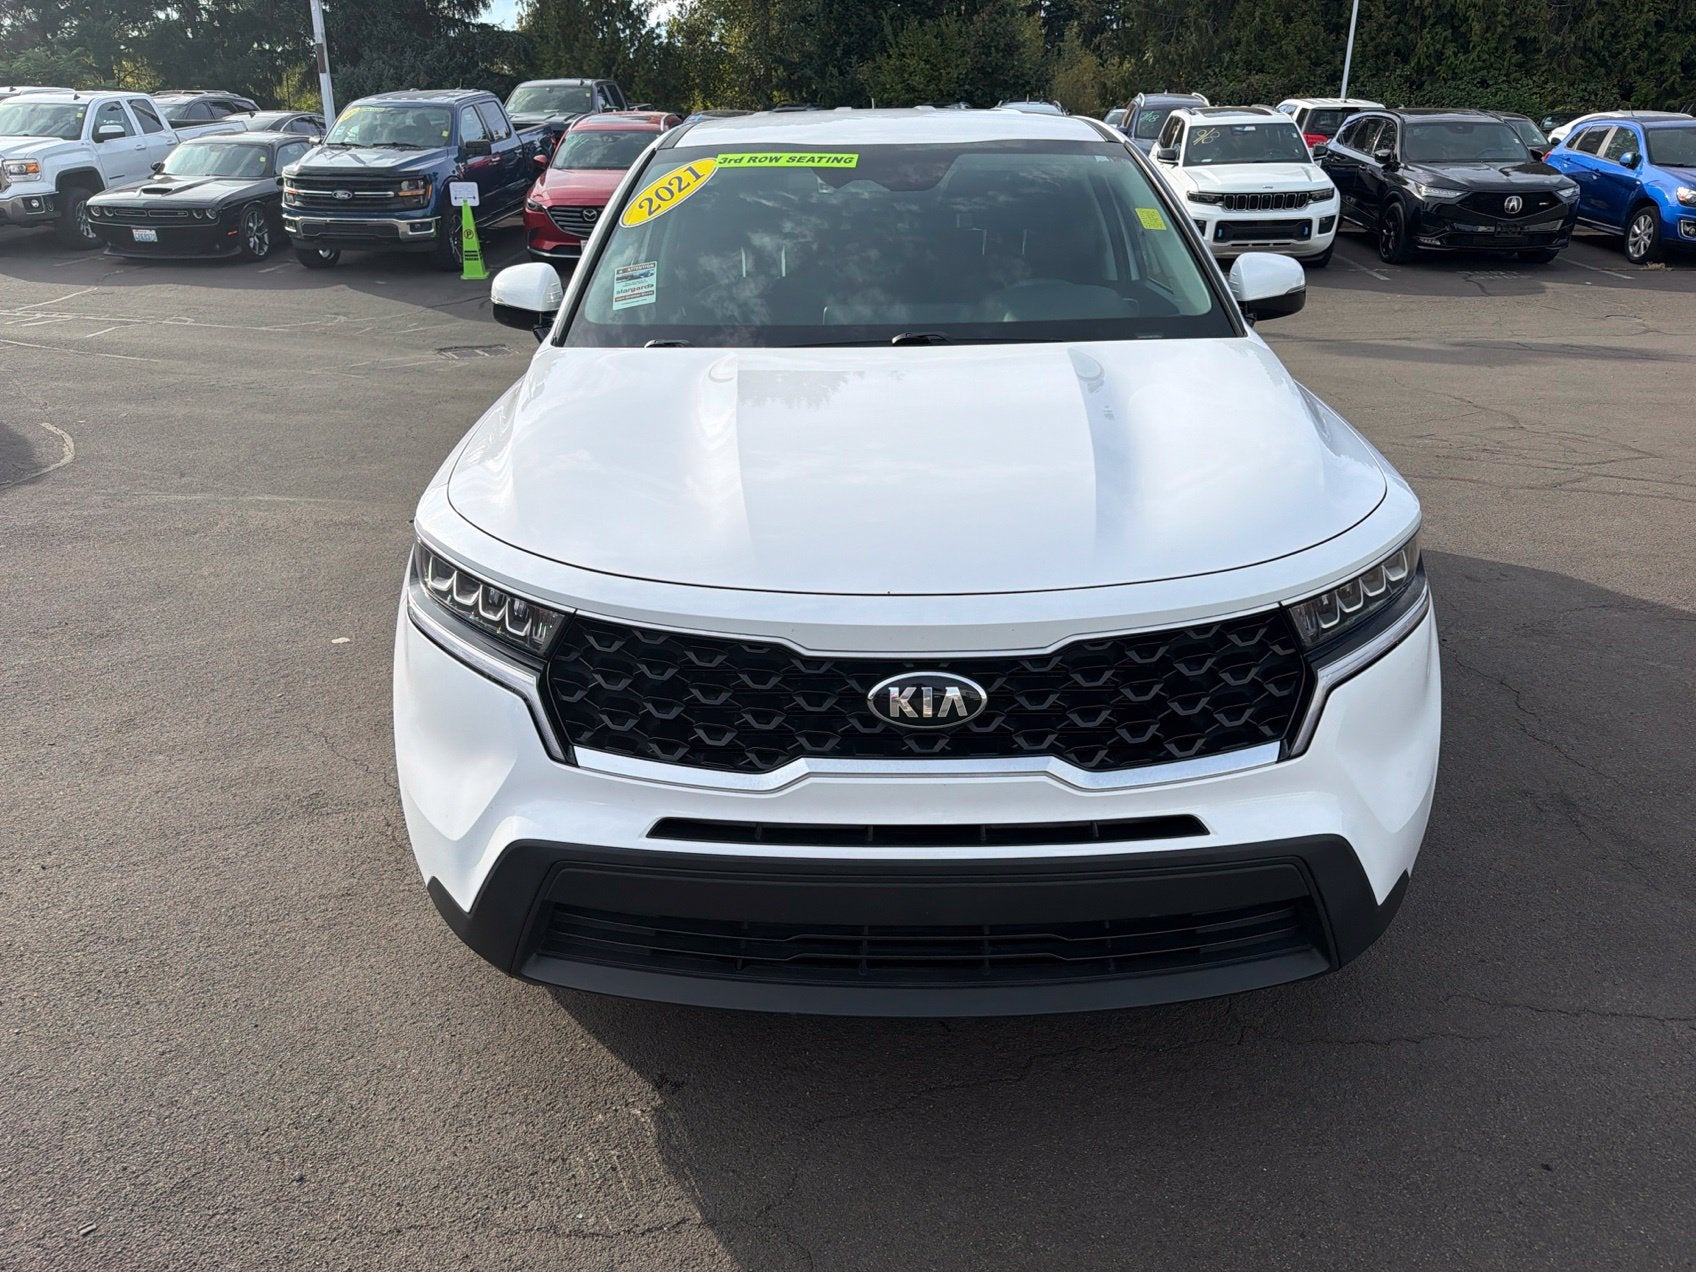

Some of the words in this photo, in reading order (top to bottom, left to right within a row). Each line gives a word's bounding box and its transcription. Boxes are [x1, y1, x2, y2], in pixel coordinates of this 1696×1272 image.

[718, 156, 743, 165] 3rd
[747, 155, 781, 164] ROW
[786, 155, 855, 165] SEATING
[638, 166, 706, 217] 2021
[888, 686, 968, 718] KIA
